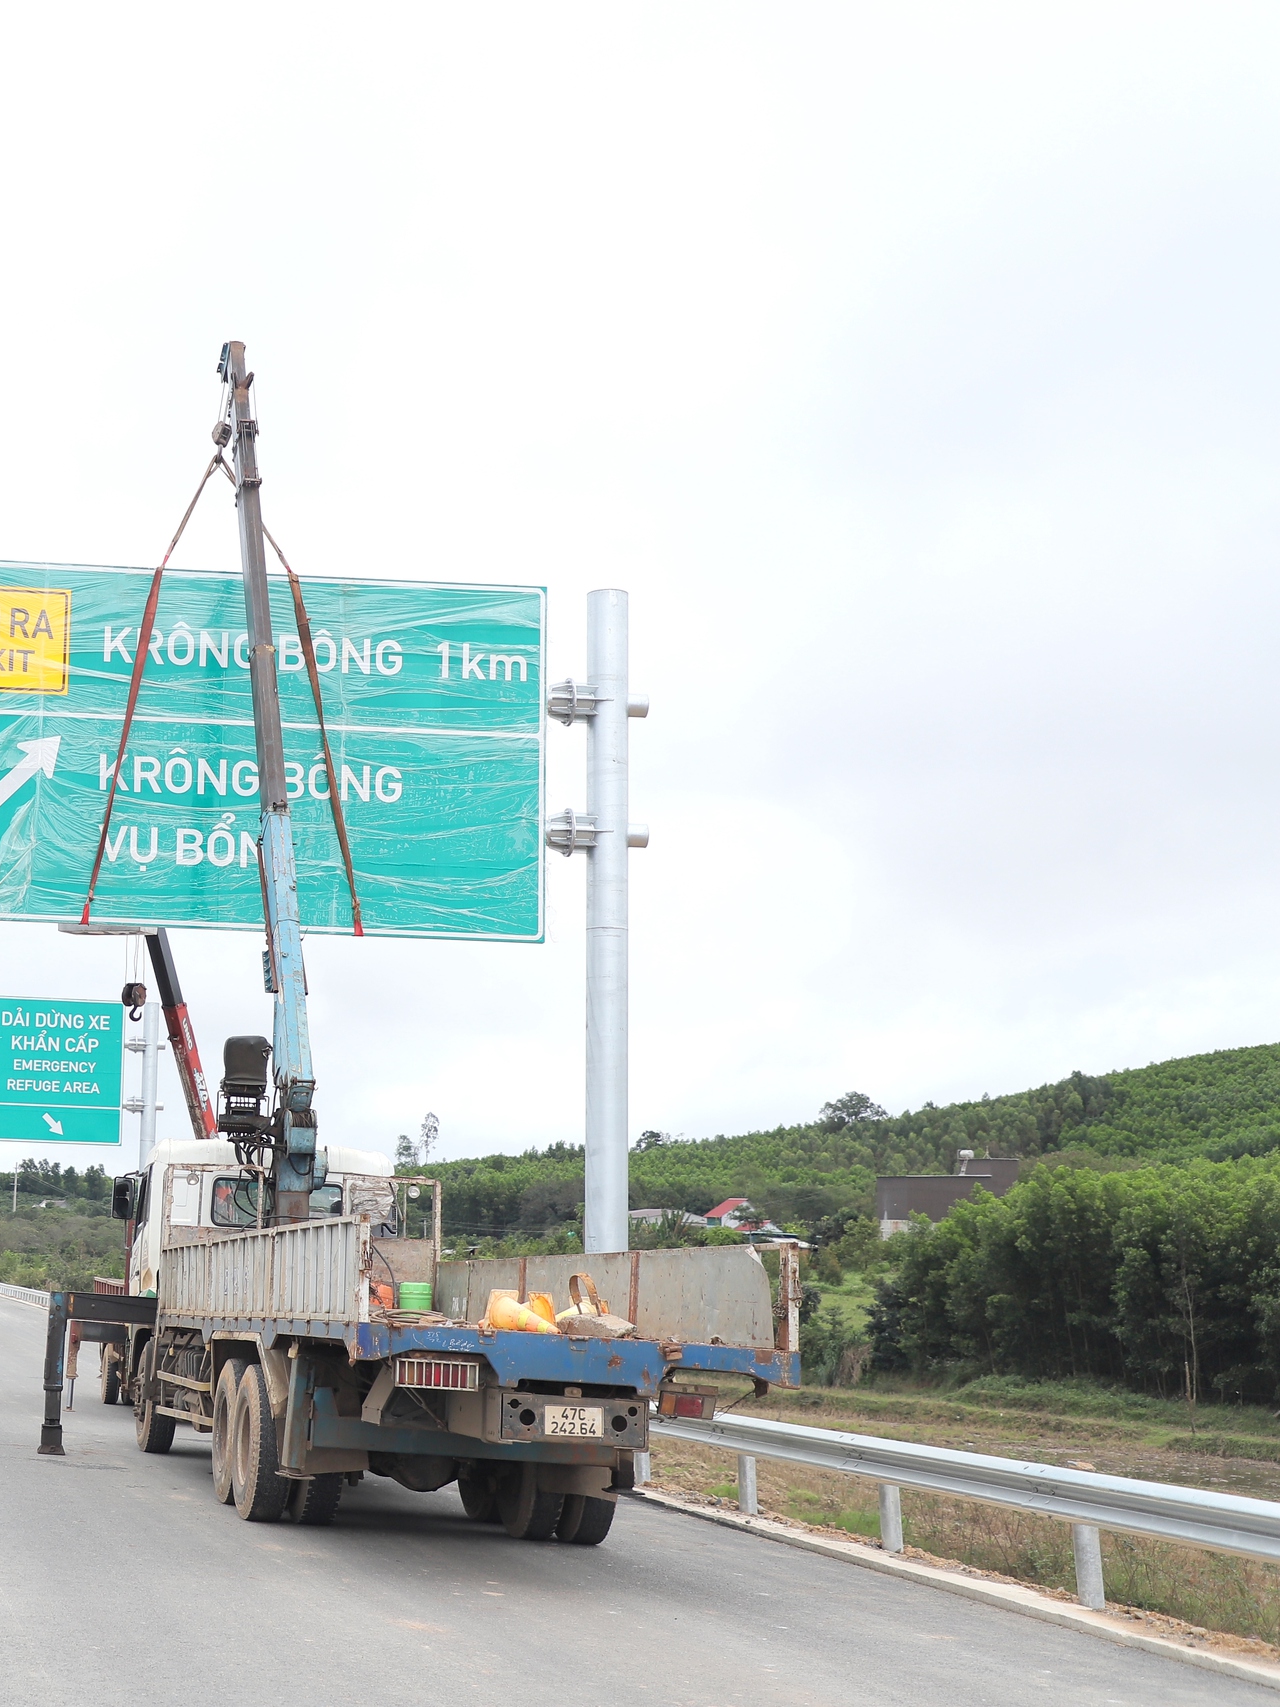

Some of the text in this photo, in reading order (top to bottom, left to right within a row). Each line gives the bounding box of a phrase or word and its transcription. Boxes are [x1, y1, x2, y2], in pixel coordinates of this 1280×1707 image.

[10, 608, 54, 639] RA
[278, 629, 403, 676] BÔNG
[99, 747, 403, 803] KRÔNG BÔNG
[98, 824, 159, 872] VỤ
[1, 1007, 110, 1030] DẢI DỪNG XE
[11, 1030, 99, 1053] KHẨN CẤP
[182, 1017, 194, 1051] UNIC
[13, 1059, 96, 1073] EMERGENCY
[7, 1078, 100, 1094] REFUGE AREA
[561, 1408, 586, 1421] 47C
[551, 1421, 596, 1435] 242.64
